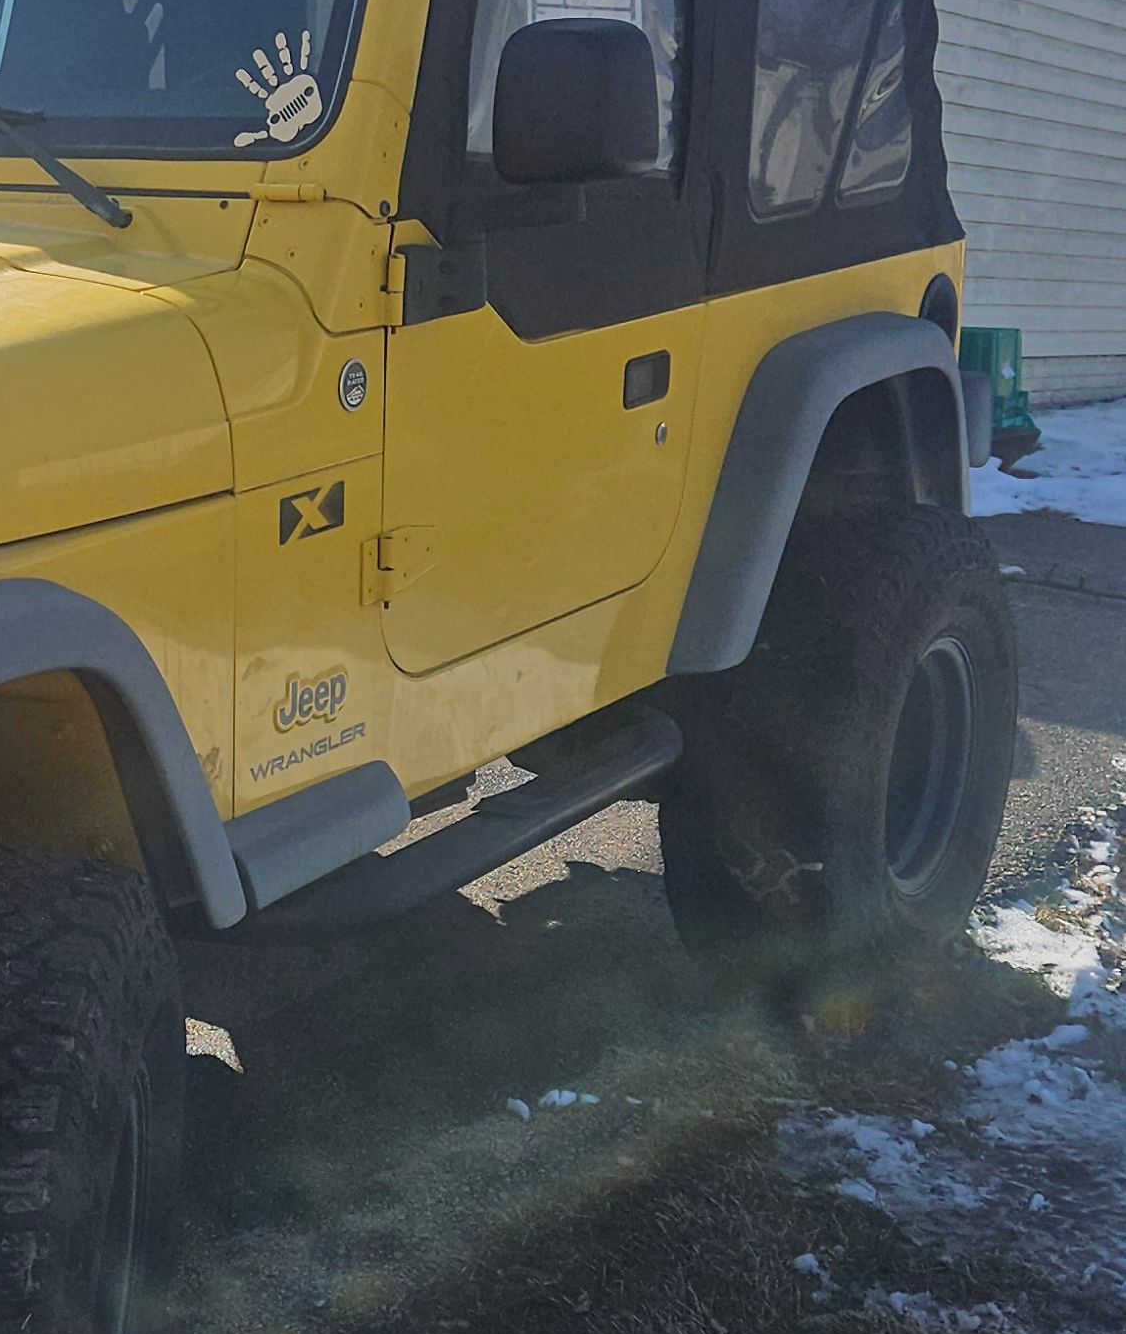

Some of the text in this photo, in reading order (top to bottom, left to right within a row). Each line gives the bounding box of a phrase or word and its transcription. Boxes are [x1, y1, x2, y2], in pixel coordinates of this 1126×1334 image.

[282, 481, 337, 545] X
[278, 672, 347, 727] Jeep
[249, 721, 366, 783] WRANGLER
